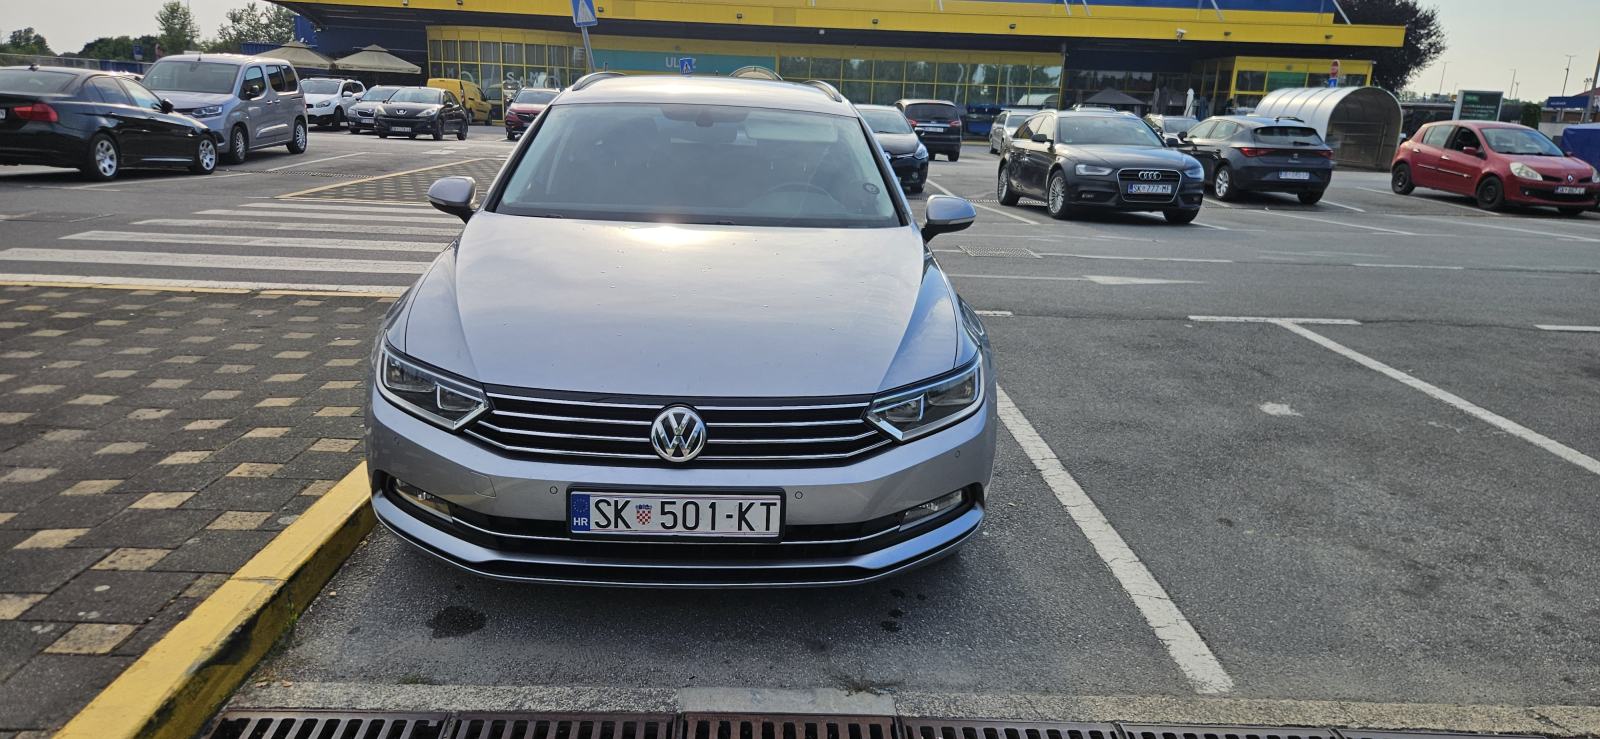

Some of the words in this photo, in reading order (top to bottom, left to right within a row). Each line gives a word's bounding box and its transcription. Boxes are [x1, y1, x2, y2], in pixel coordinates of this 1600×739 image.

[573, 517, 589, 527] HR
[594, 498, 632, 529] SK
[660, 500, 778, 531] 501-KT
